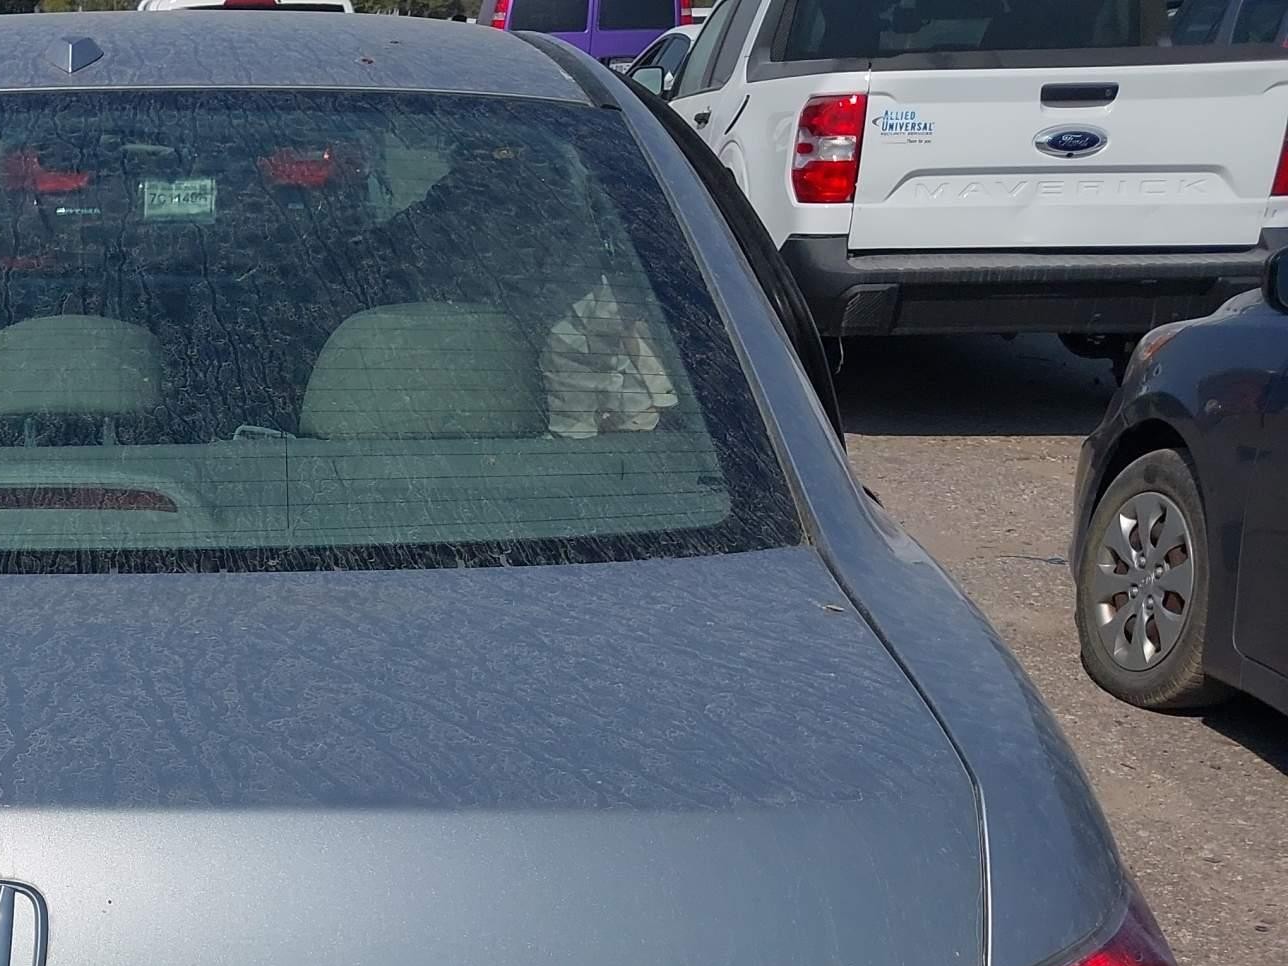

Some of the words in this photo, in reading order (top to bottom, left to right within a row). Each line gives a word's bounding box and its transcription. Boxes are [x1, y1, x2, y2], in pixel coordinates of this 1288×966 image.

[882, 109, 916, 121] ALLIED
[881, 120, 933, 132] UNIVERSAL
[913, 178, 1207, 200] MAVERICK
